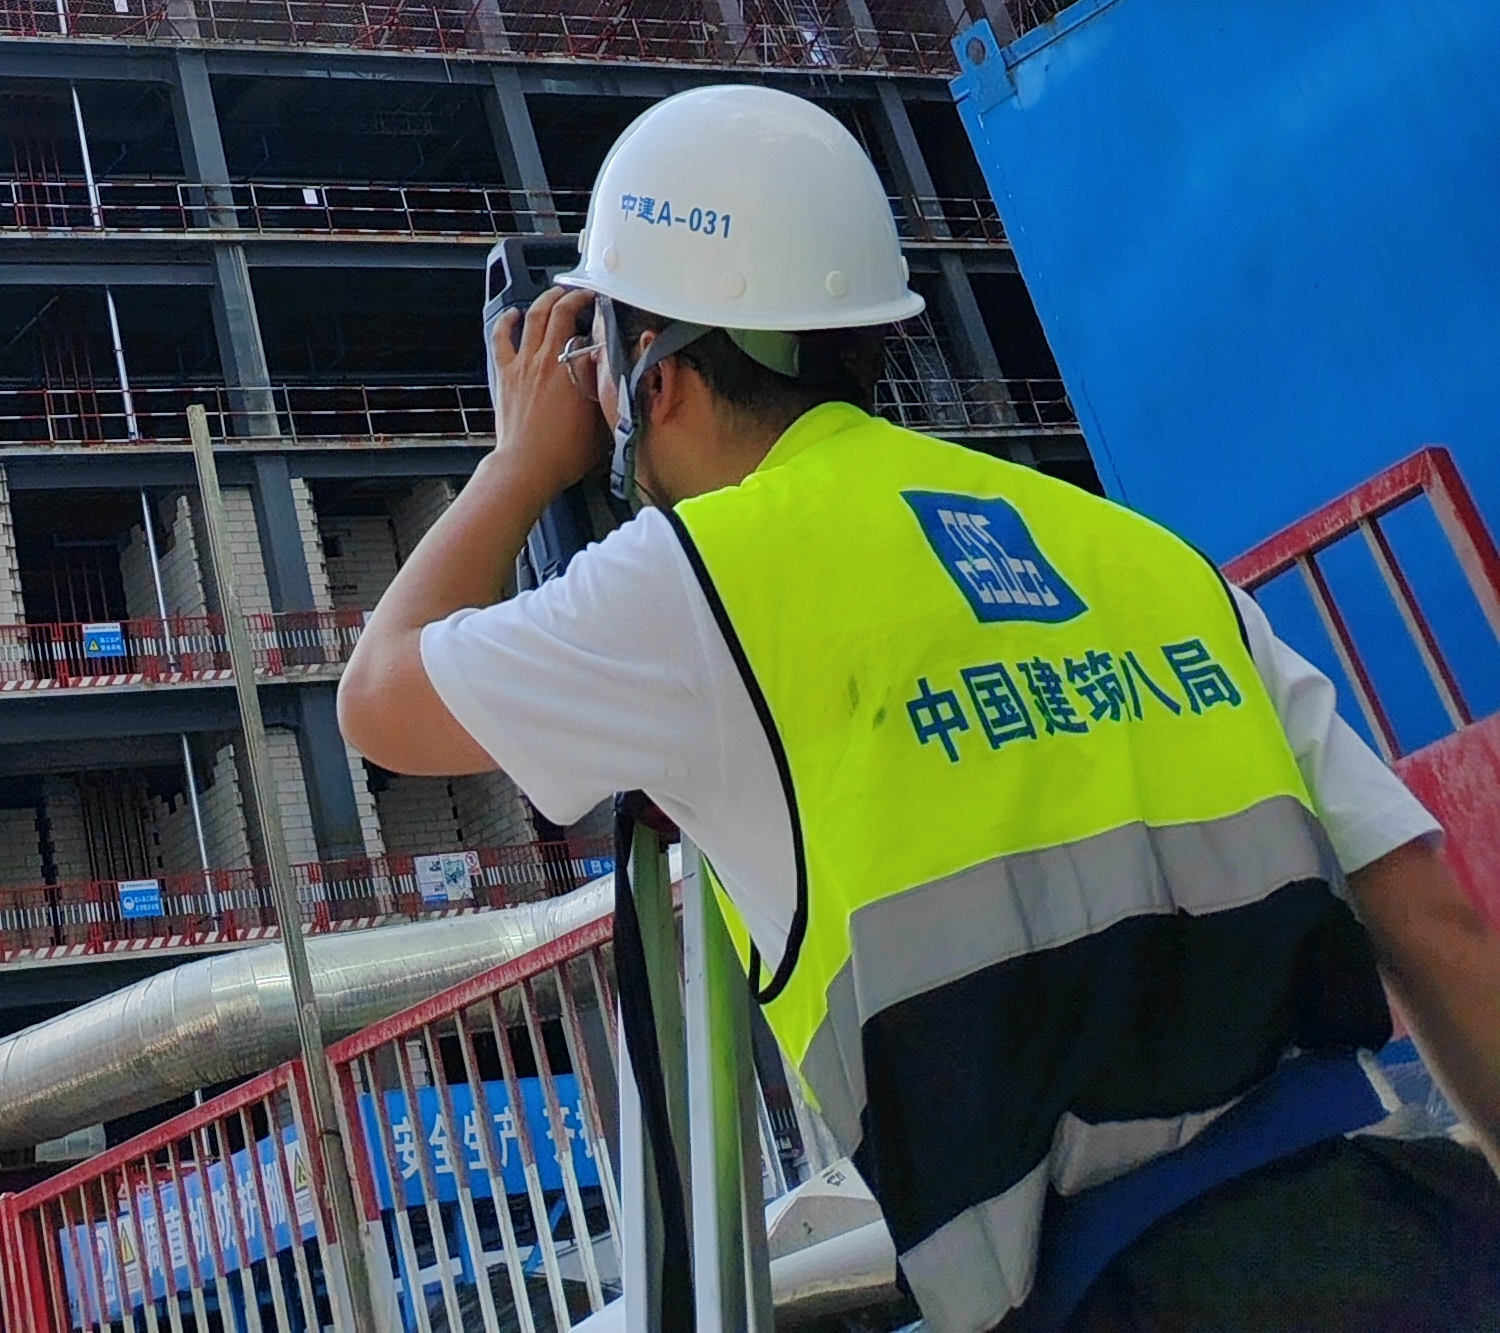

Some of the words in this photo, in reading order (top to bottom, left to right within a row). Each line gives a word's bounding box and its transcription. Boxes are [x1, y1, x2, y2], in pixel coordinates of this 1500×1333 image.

[906, 639, 1241, 762] 中国建筑八局
